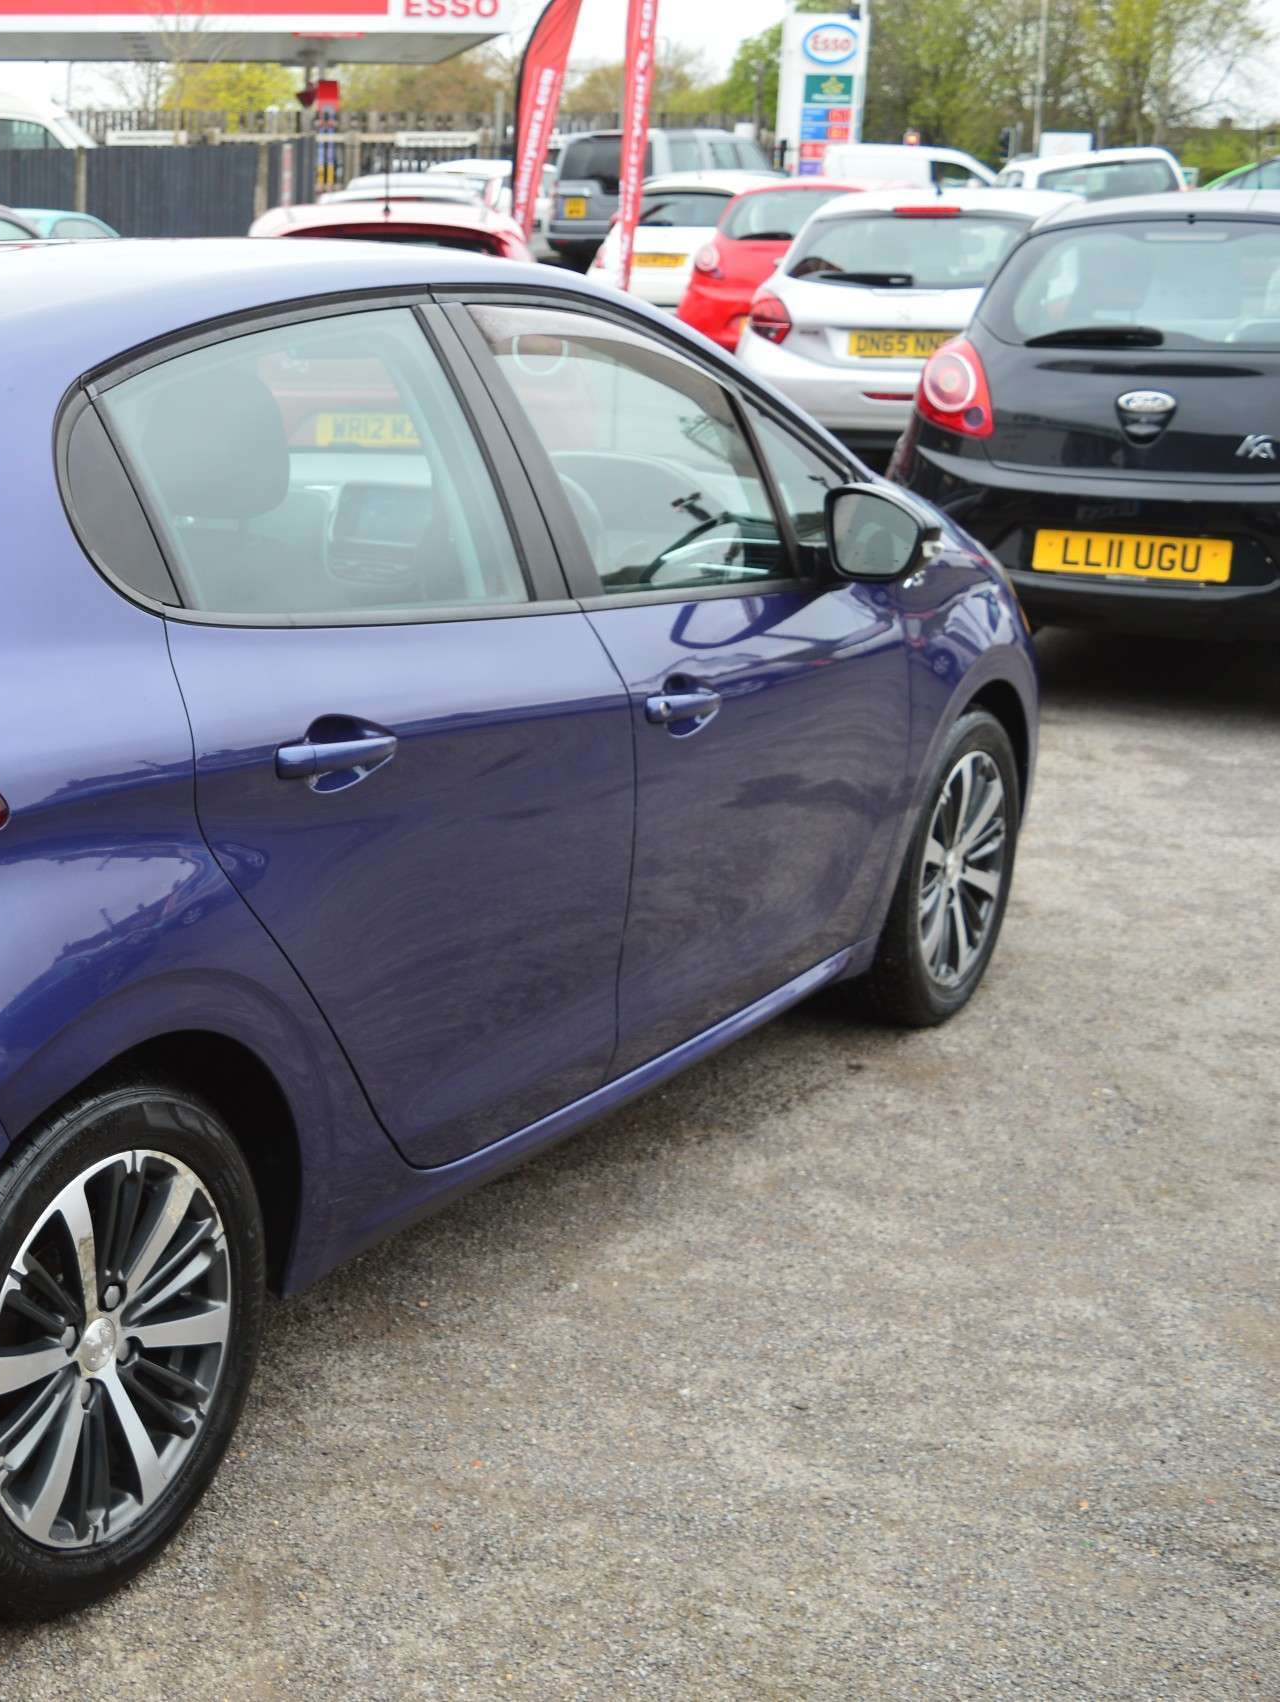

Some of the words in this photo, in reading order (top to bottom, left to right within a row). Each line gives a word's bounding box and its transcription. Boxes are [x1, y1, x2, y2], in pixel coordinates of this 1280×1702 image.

[404, 0, 499, 18] ESSO
[811, 33, 852, 52] Esso
[856, 334, 908, 352] DN65
[1061, 536, 1124, 568] LL11
[1133, 541, 1202, 573] UGU
